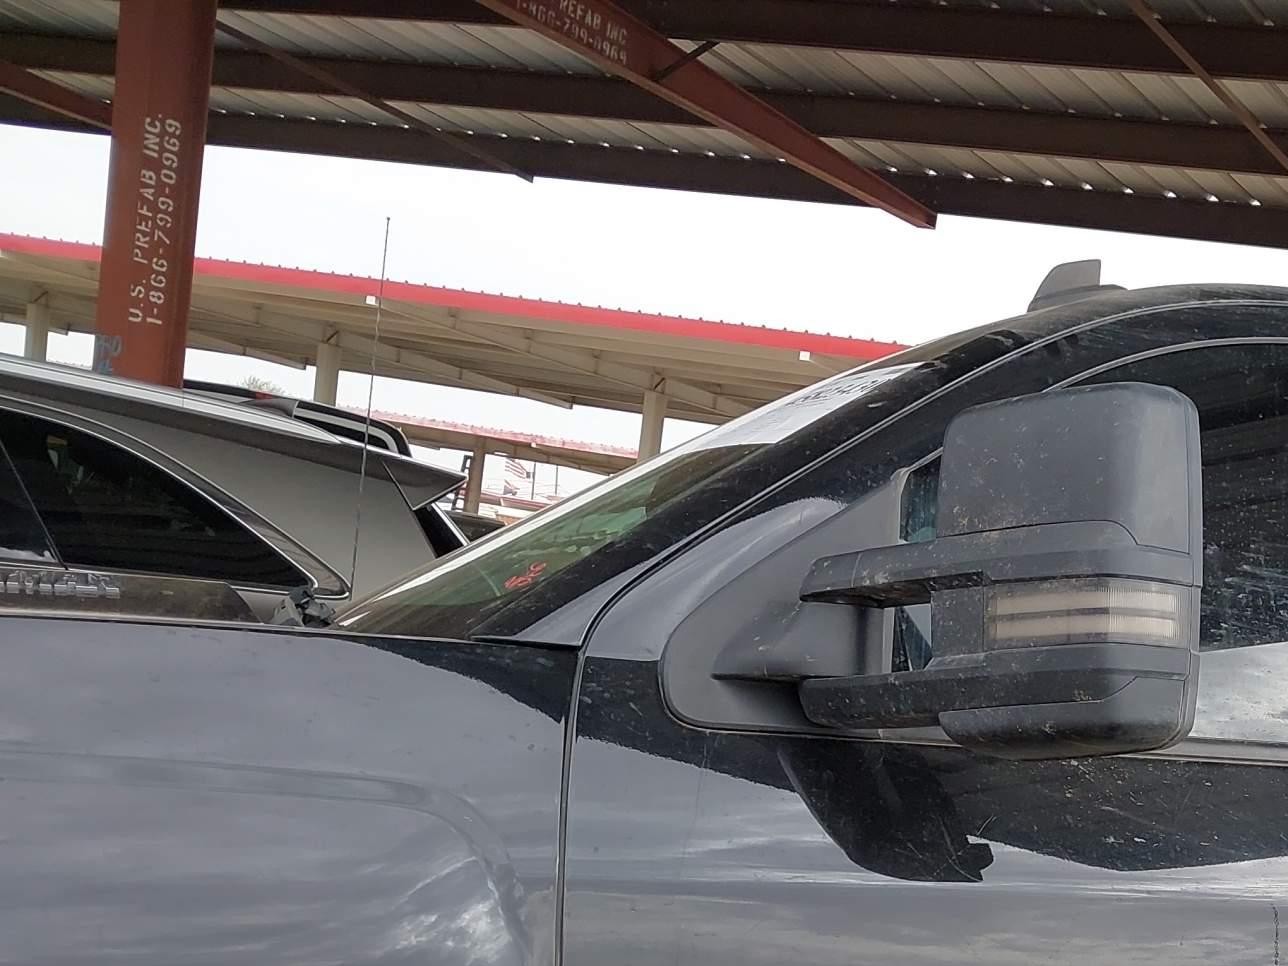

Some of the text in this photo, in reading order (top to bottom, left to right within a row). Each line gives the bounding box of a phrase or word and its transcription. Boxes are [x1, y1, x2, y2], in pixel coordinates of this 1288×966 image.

[128, 114, 163, 323] U.S. PREFAB INC.
[146, 119, 182, 325] 1-866-799-0969
